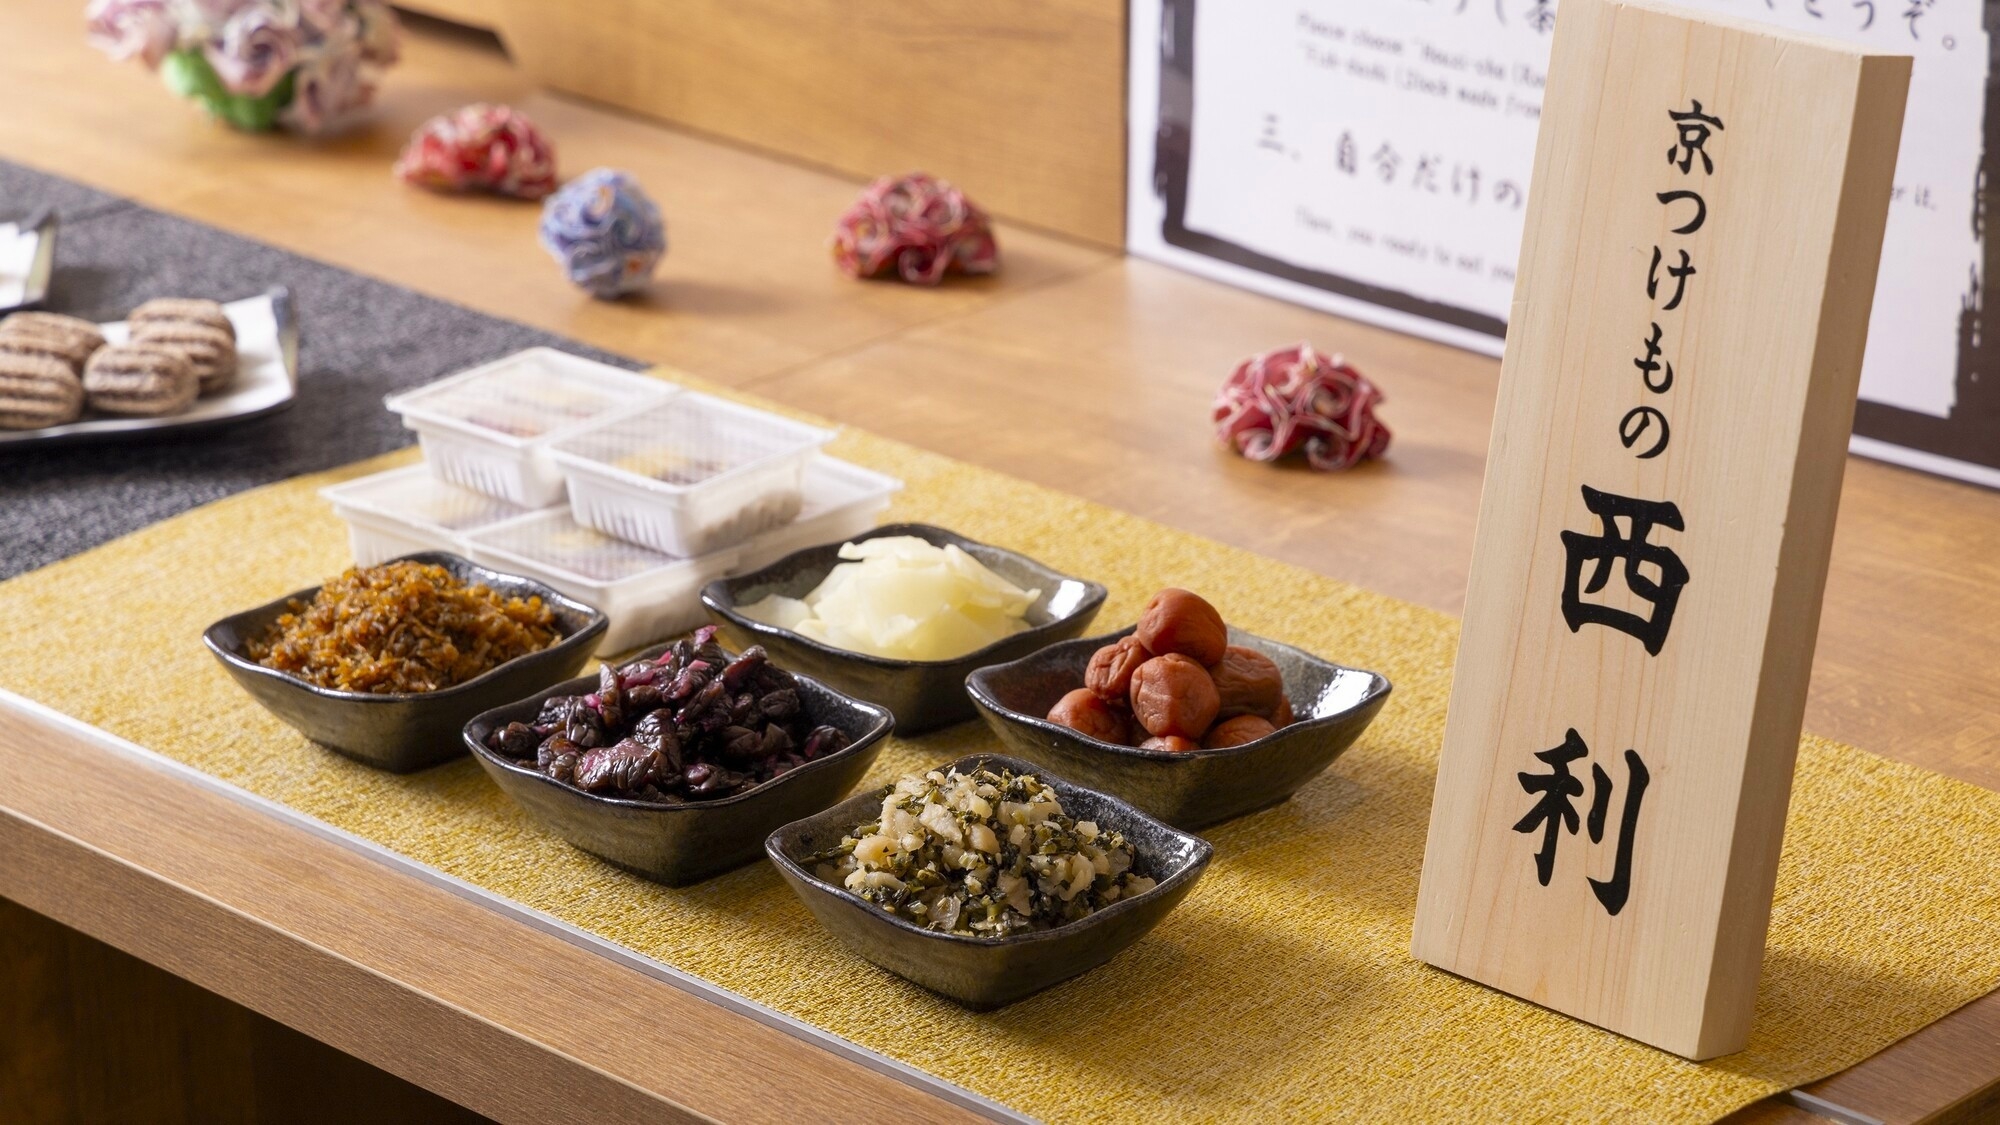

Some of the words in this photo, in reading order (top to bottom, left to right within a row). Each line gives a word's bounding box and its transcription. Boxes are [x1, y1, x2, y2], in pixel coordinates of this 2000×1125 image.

[1334, 130, 1524, 211] 自分だけの
[1619, 99, 1725, 459] 京つけもの
[1511, 484, 1690, 917] 西利
